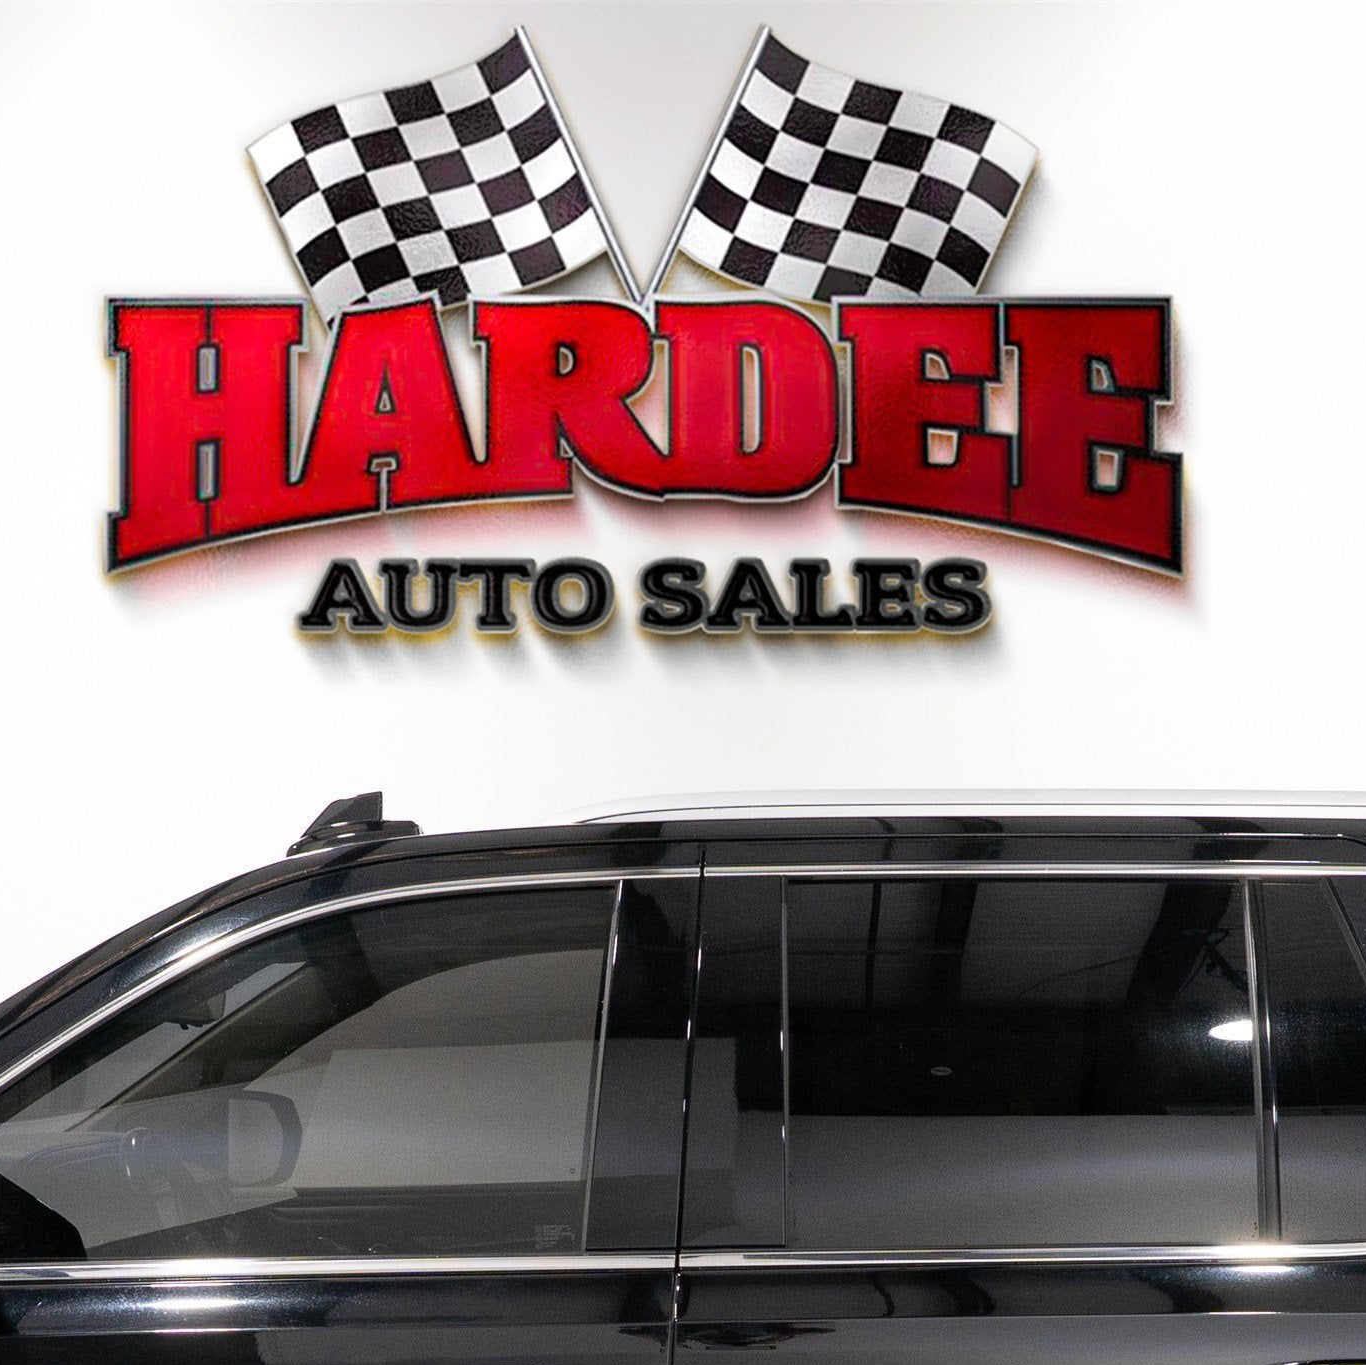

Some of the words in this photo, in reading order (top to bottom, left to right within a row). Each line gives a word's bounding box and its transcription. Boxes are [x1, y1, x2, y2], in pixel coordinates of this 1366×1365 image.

[105, 295, 1184, 578] HARDEE
[299, 557, 610, 634] AUTO
[638, 557, 990, 635] SALES
